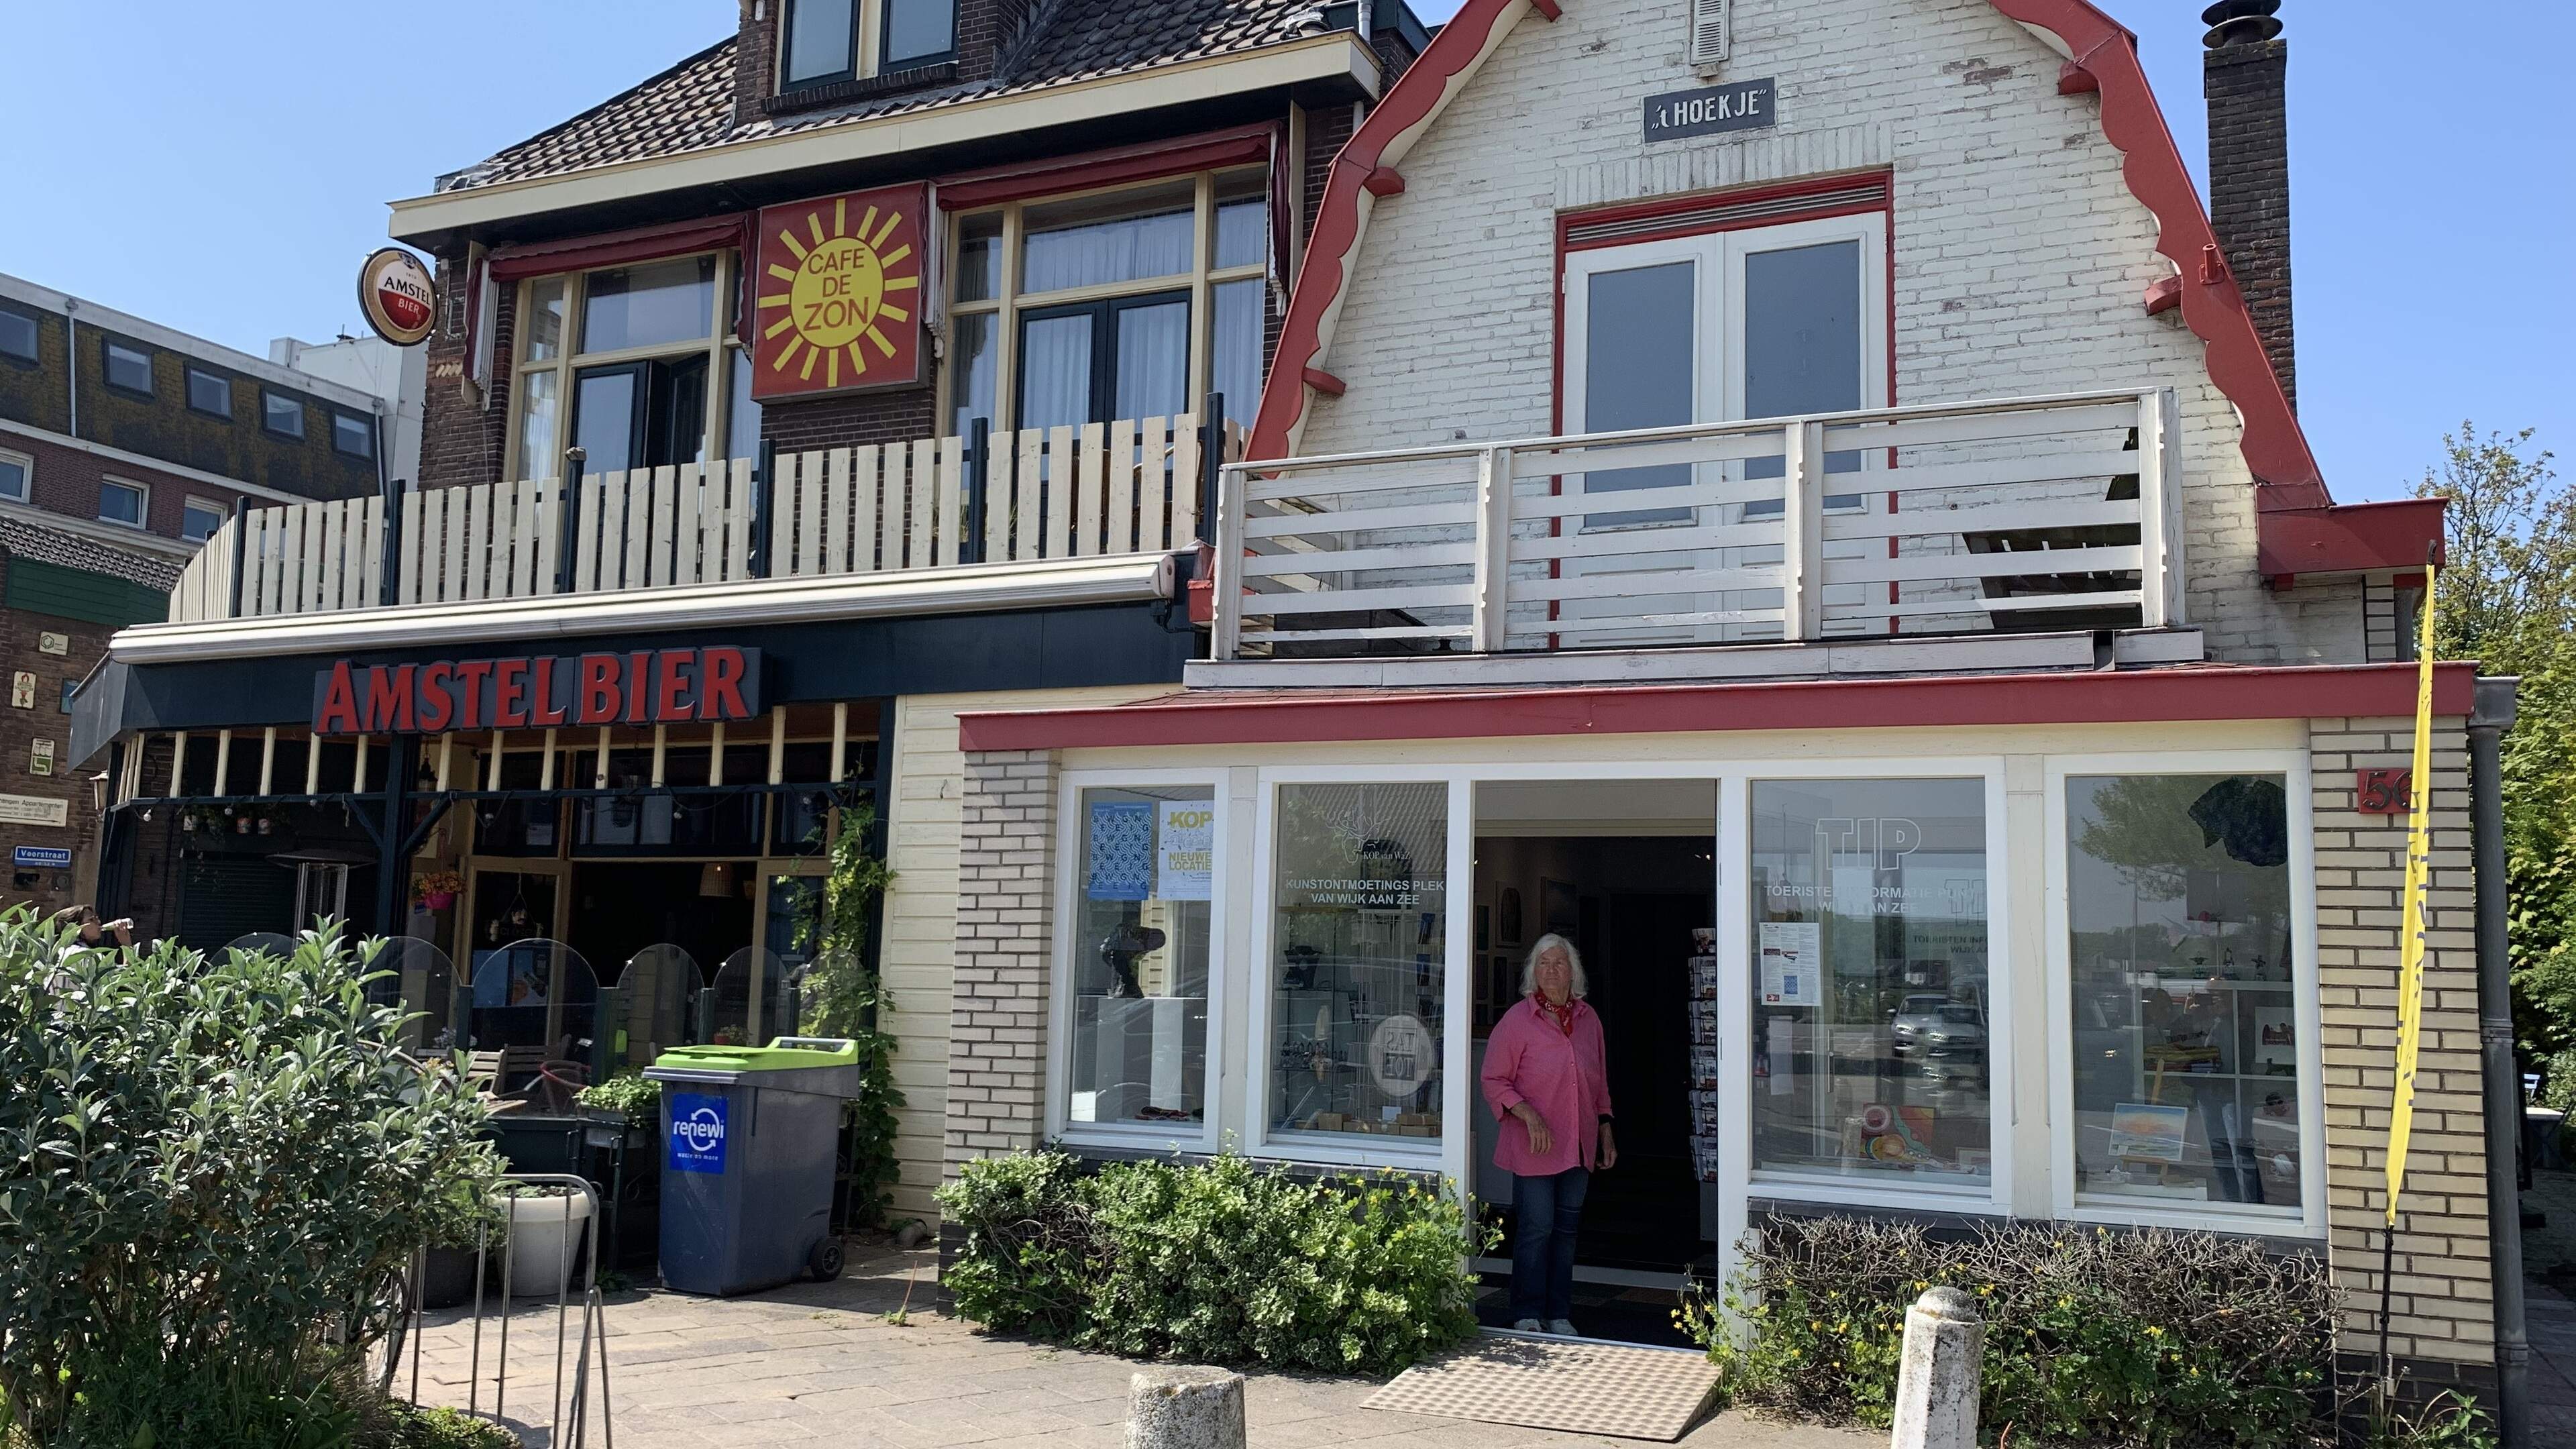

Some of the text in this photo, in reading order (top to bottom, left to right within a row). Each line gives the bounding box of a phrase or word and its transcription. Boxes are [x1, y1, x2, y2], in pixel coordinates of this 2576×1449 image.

[808, 248, 865, 274] CAFE
[384, 276, 431, 305] AMSTEL
[822, 274, 852, 297] DE
[398, 298, 420, 315] BIER
[803, 297, 869, 331] ZON
[315, 648, 752, 733] AMSTEL BIER
[1170, 811, 1214, 828] KOP
[1815, 818, 1921, 871] TIP
[21, 849, 66, 859] Voorstraat
[1169, 852, 1212, 861] NIEUWE
[1363, 851, 1380, 859] KOP
[1169, 861, 1212, 871] LOCATIE
[1287, 879, 1444, 891] KUNSTONTMOETINGS PLEK
[1311, 893, 1419, 905] VAN WIJK AAN ZEE
[674, 1120, 724, 1138] renewi
